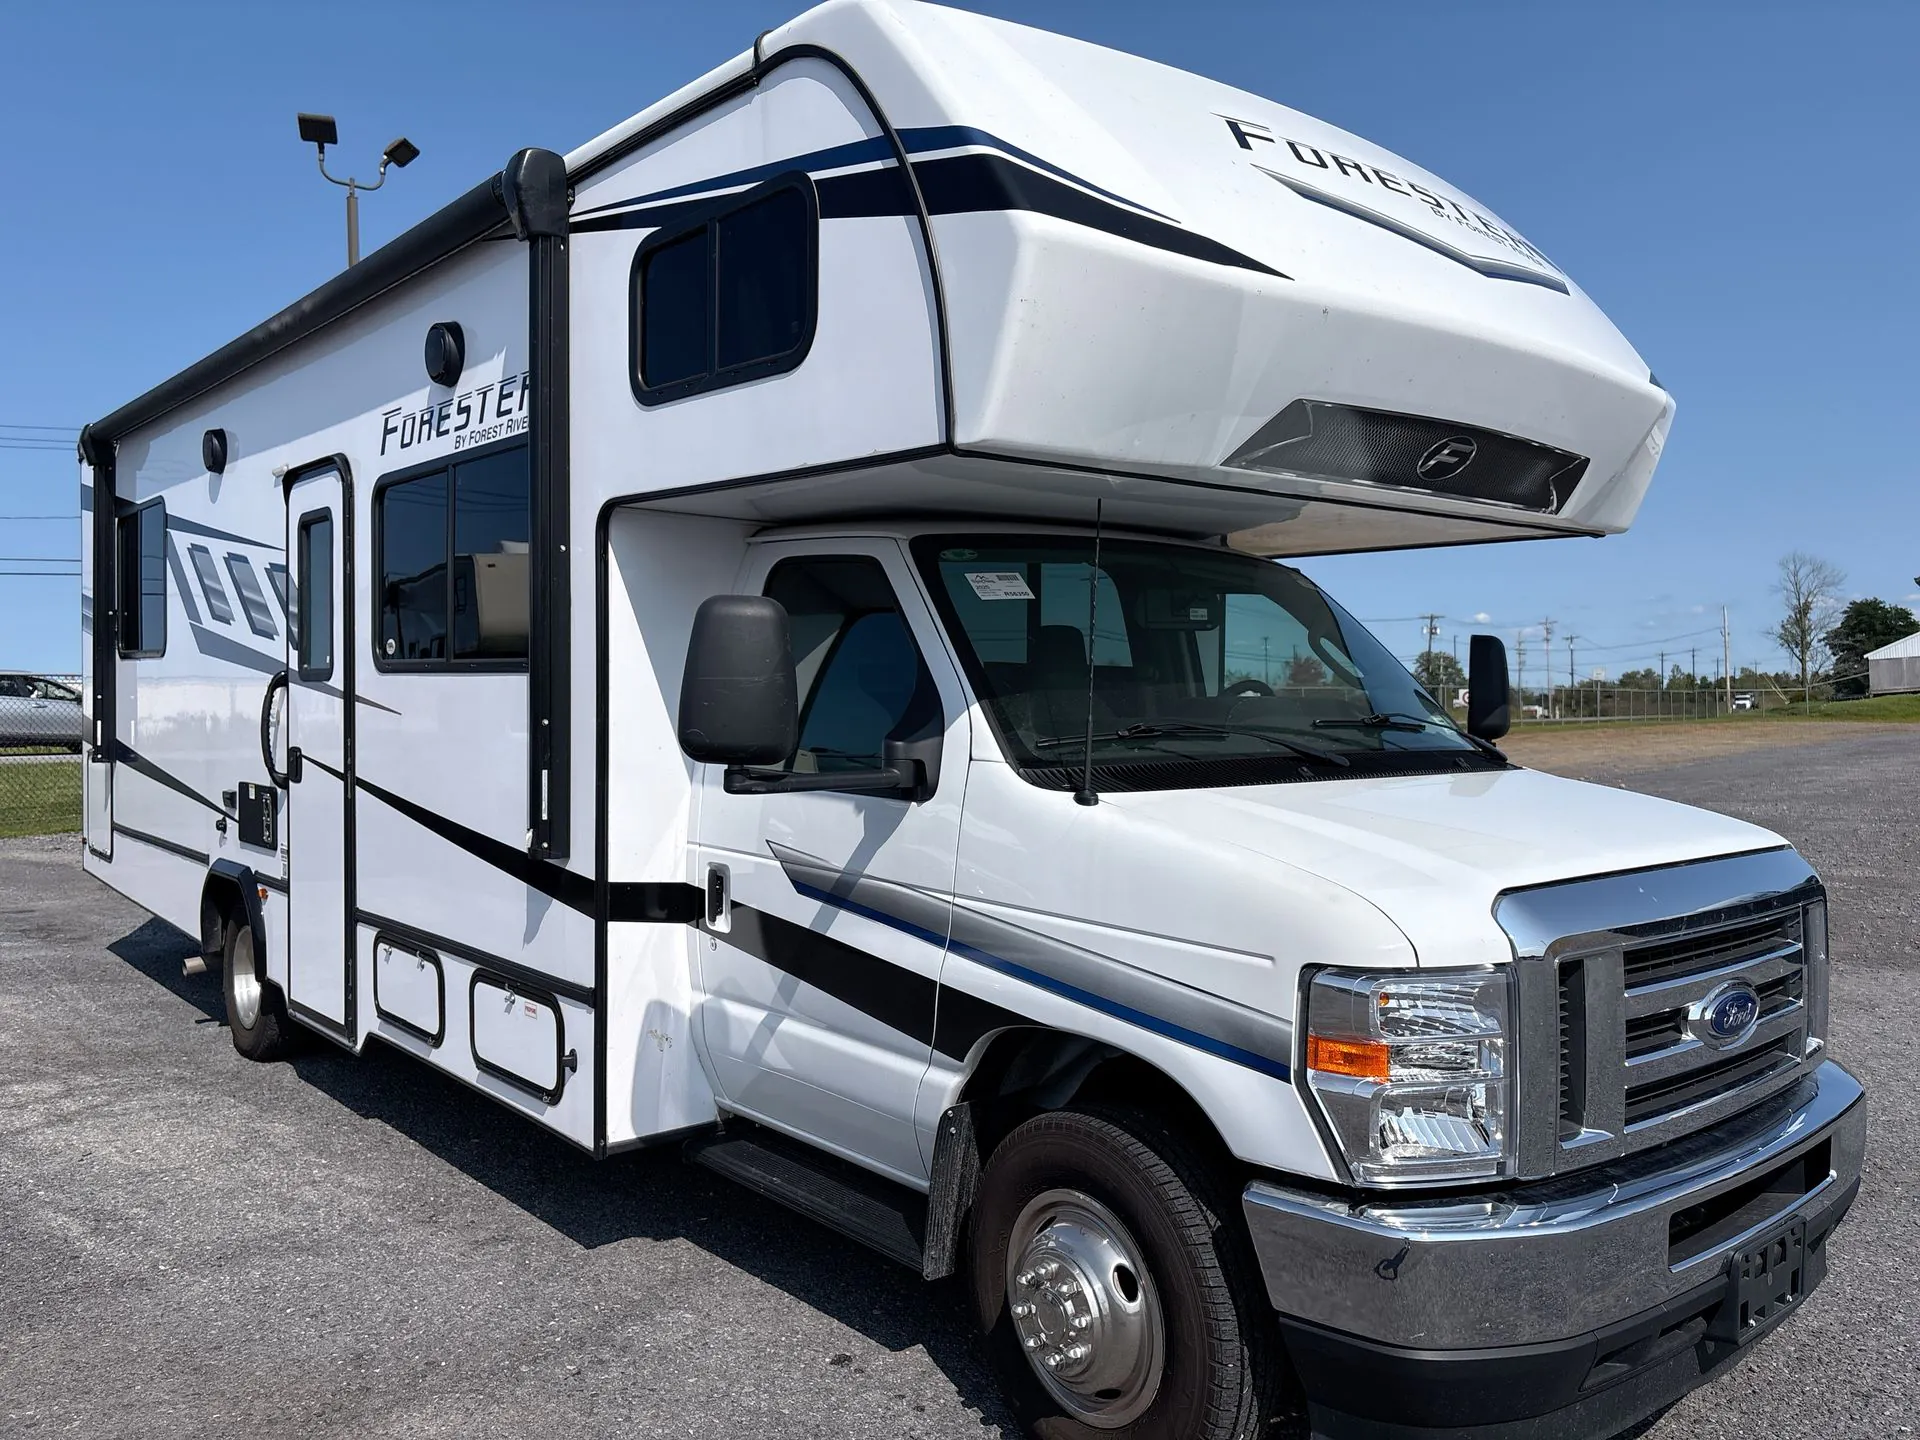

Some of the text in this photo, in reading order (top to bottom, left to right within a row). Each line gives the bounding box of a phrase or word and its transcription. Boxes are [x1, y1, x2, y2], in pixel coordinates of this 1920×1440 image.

[1210, 111, 1536, 258] FORESTER
[1430, 206, 1453, 222] BY
[1455, 217, 1506, 248] FOREST
[454, 415, 529, 450] BY FOREST RIVE
[1723, 1001, 1752, 1029] Ford
